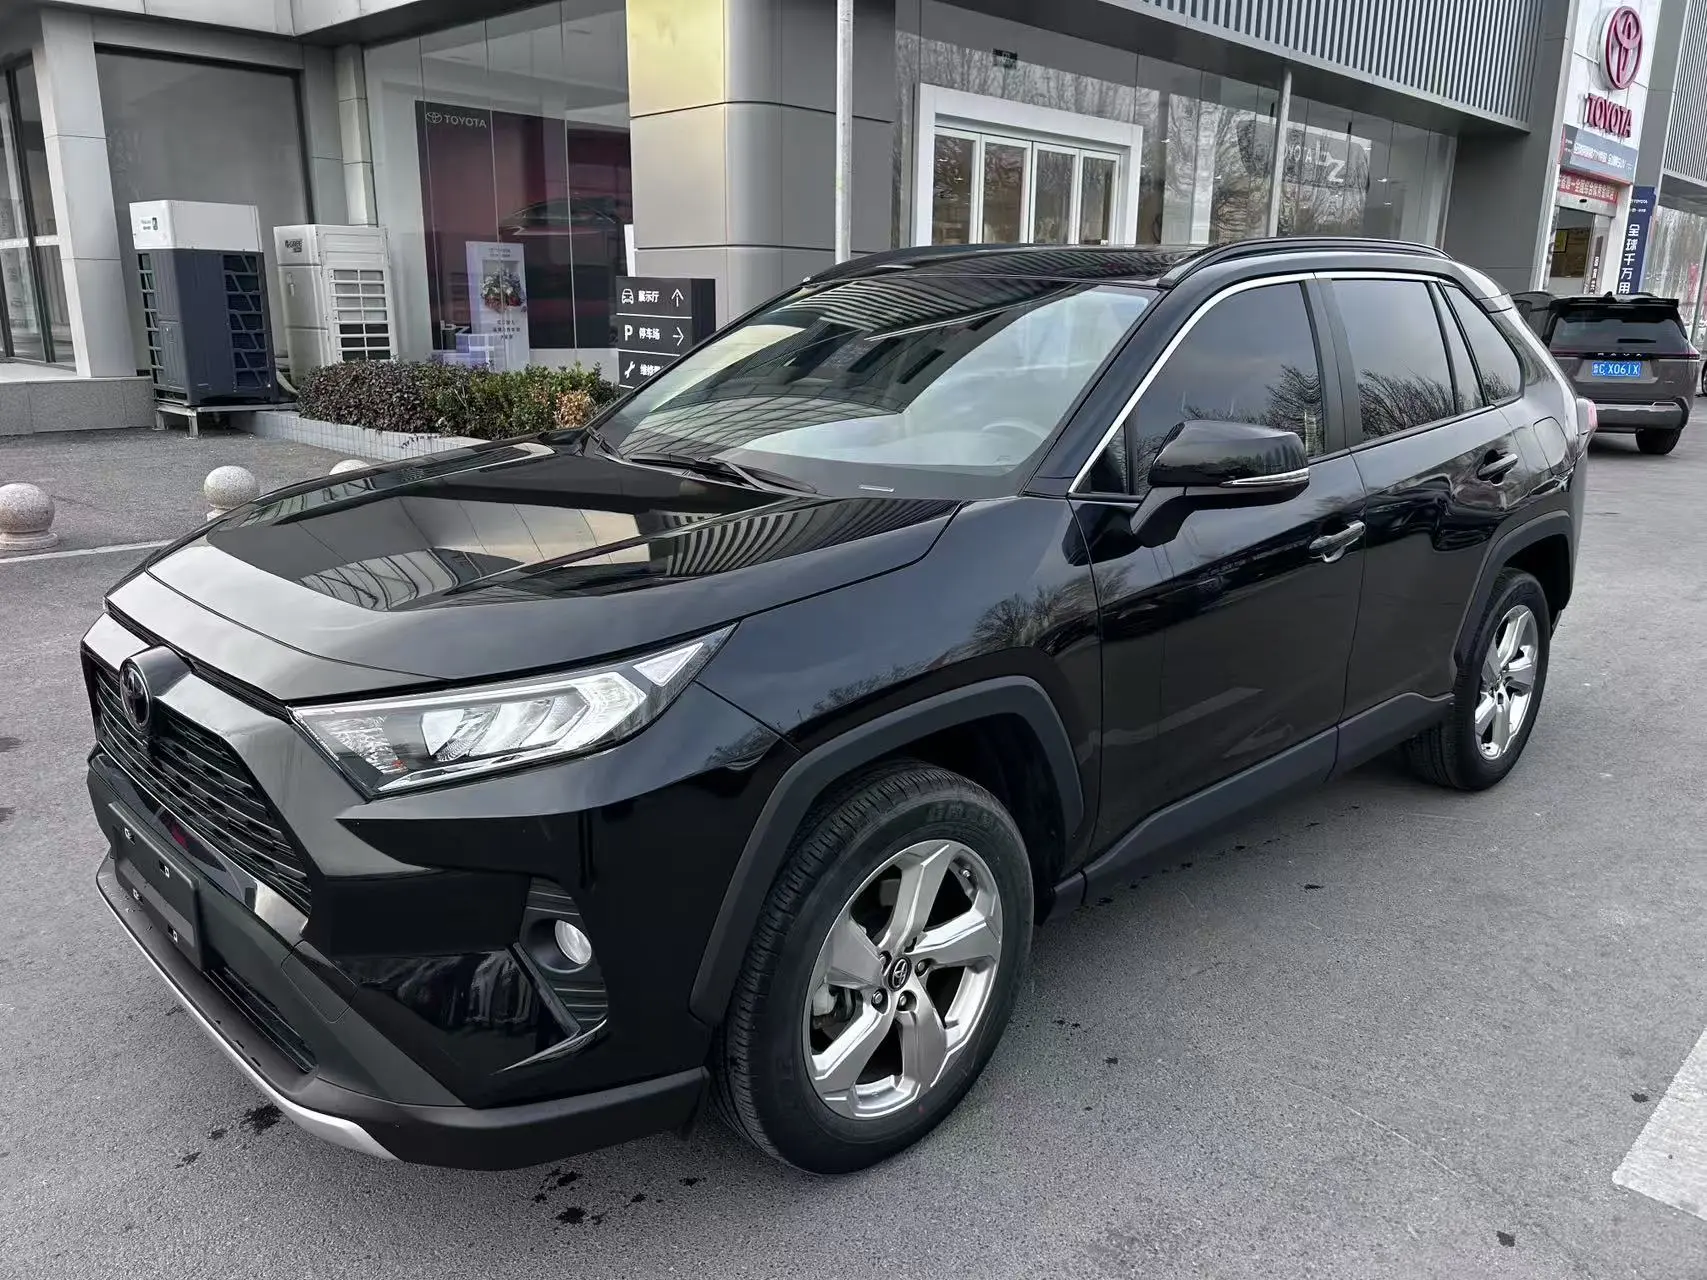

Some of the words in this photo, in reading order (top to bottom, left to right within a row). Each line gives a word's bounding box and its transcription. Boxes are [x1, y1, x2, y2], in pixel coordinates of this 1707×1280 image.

[444, 114, 487, 128] TOYOTA
[1586, 93, 1632, 138] TOYOTA
[1618, 223, 1640, 294] 全球千万用
[638, 290, 659, 303] 展示厅
[624, 324, 633, 341] P
[639, 327, 660, 340] 停车场
